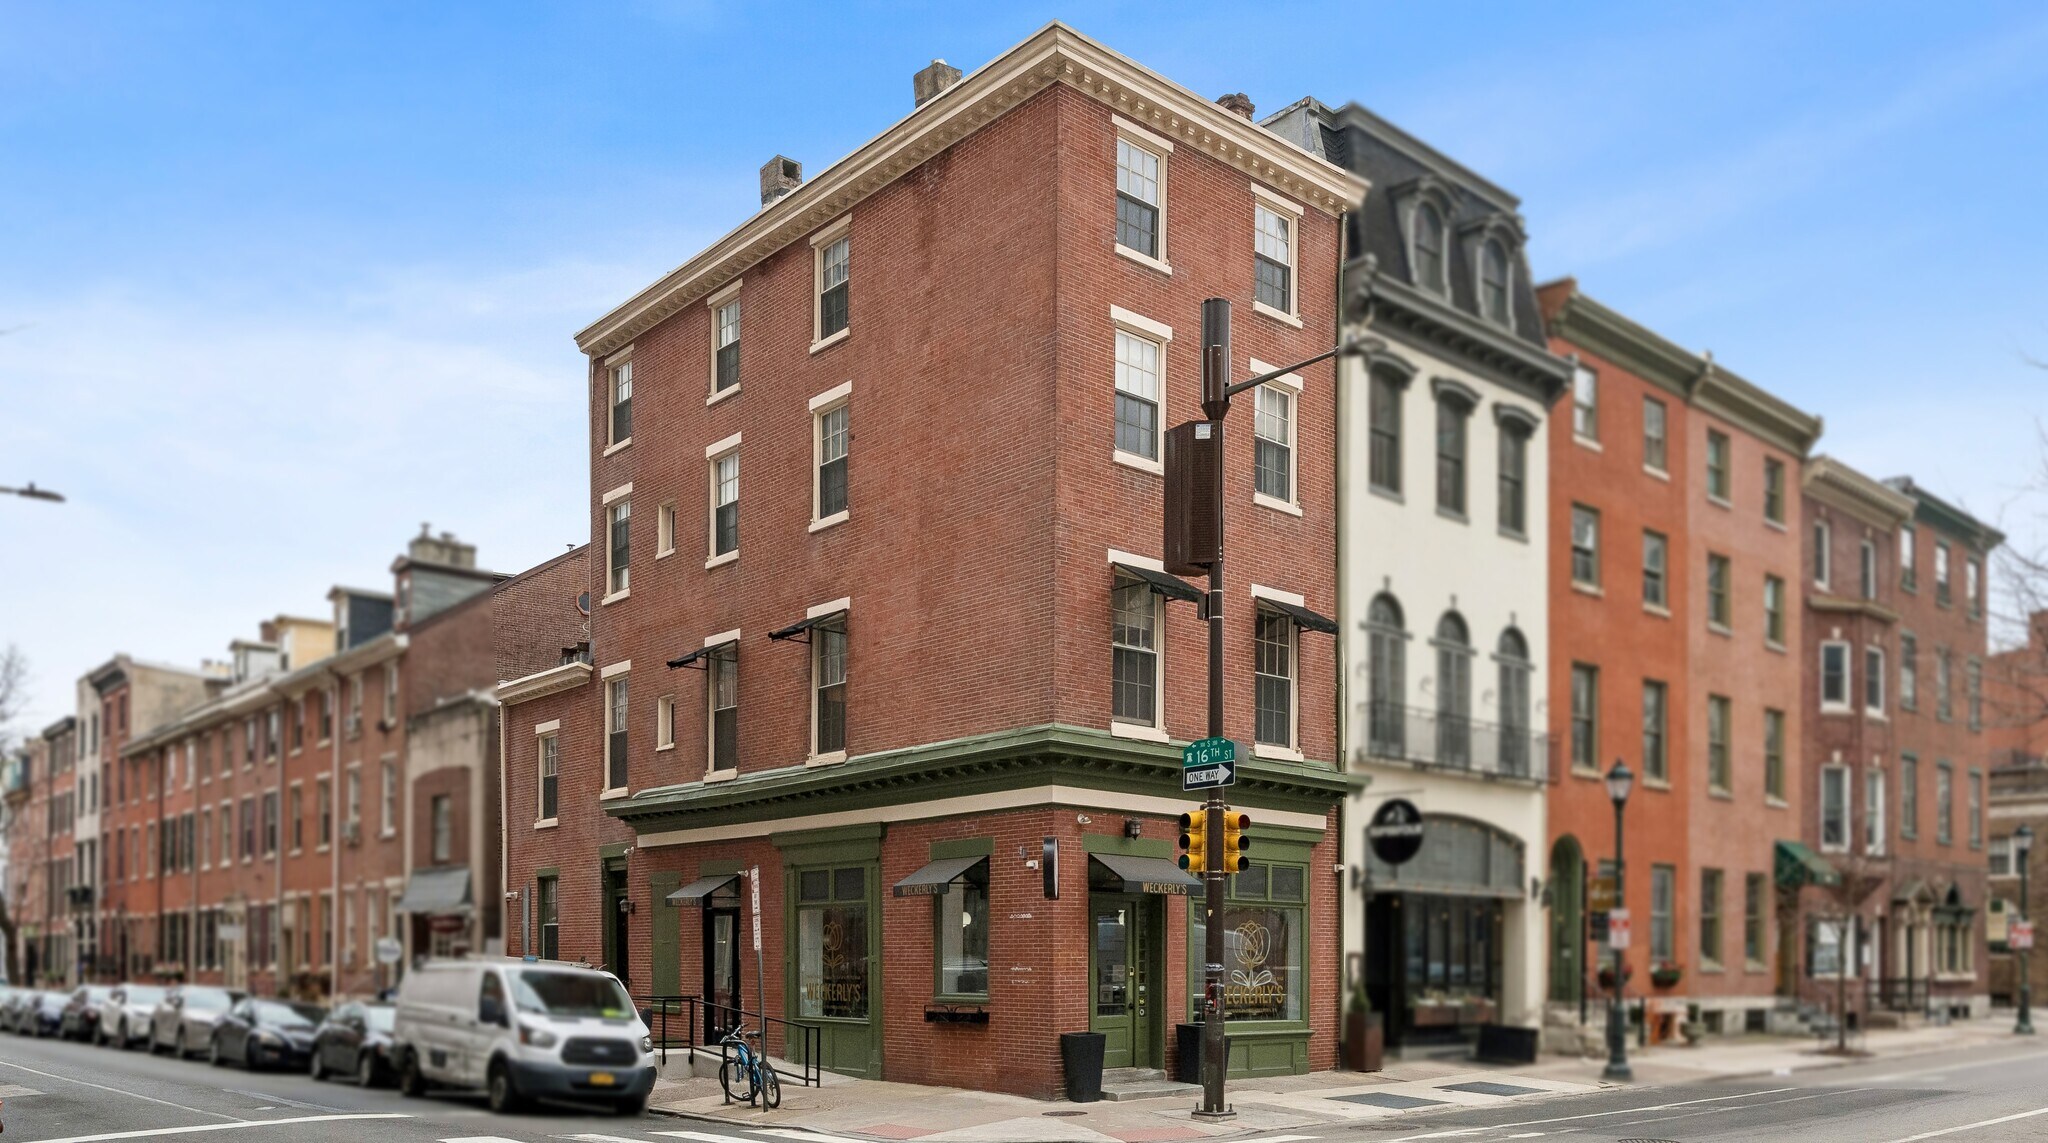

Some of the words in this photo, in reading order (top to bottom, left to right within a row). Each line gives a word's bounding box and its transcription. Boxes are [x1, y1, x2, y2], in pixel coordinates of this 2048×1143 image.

[1224, 749, 1233, 760] ST
[1188, 771, 1204, 783] ONE
[1205, 769, 1220, 781] WAY
[1142, 881, 1187, 895] WECKERLY'S
[806, 982, 861, 1003] WECKERLY'S
[1224, 984, 1284, 1005] ECKERLY'S
